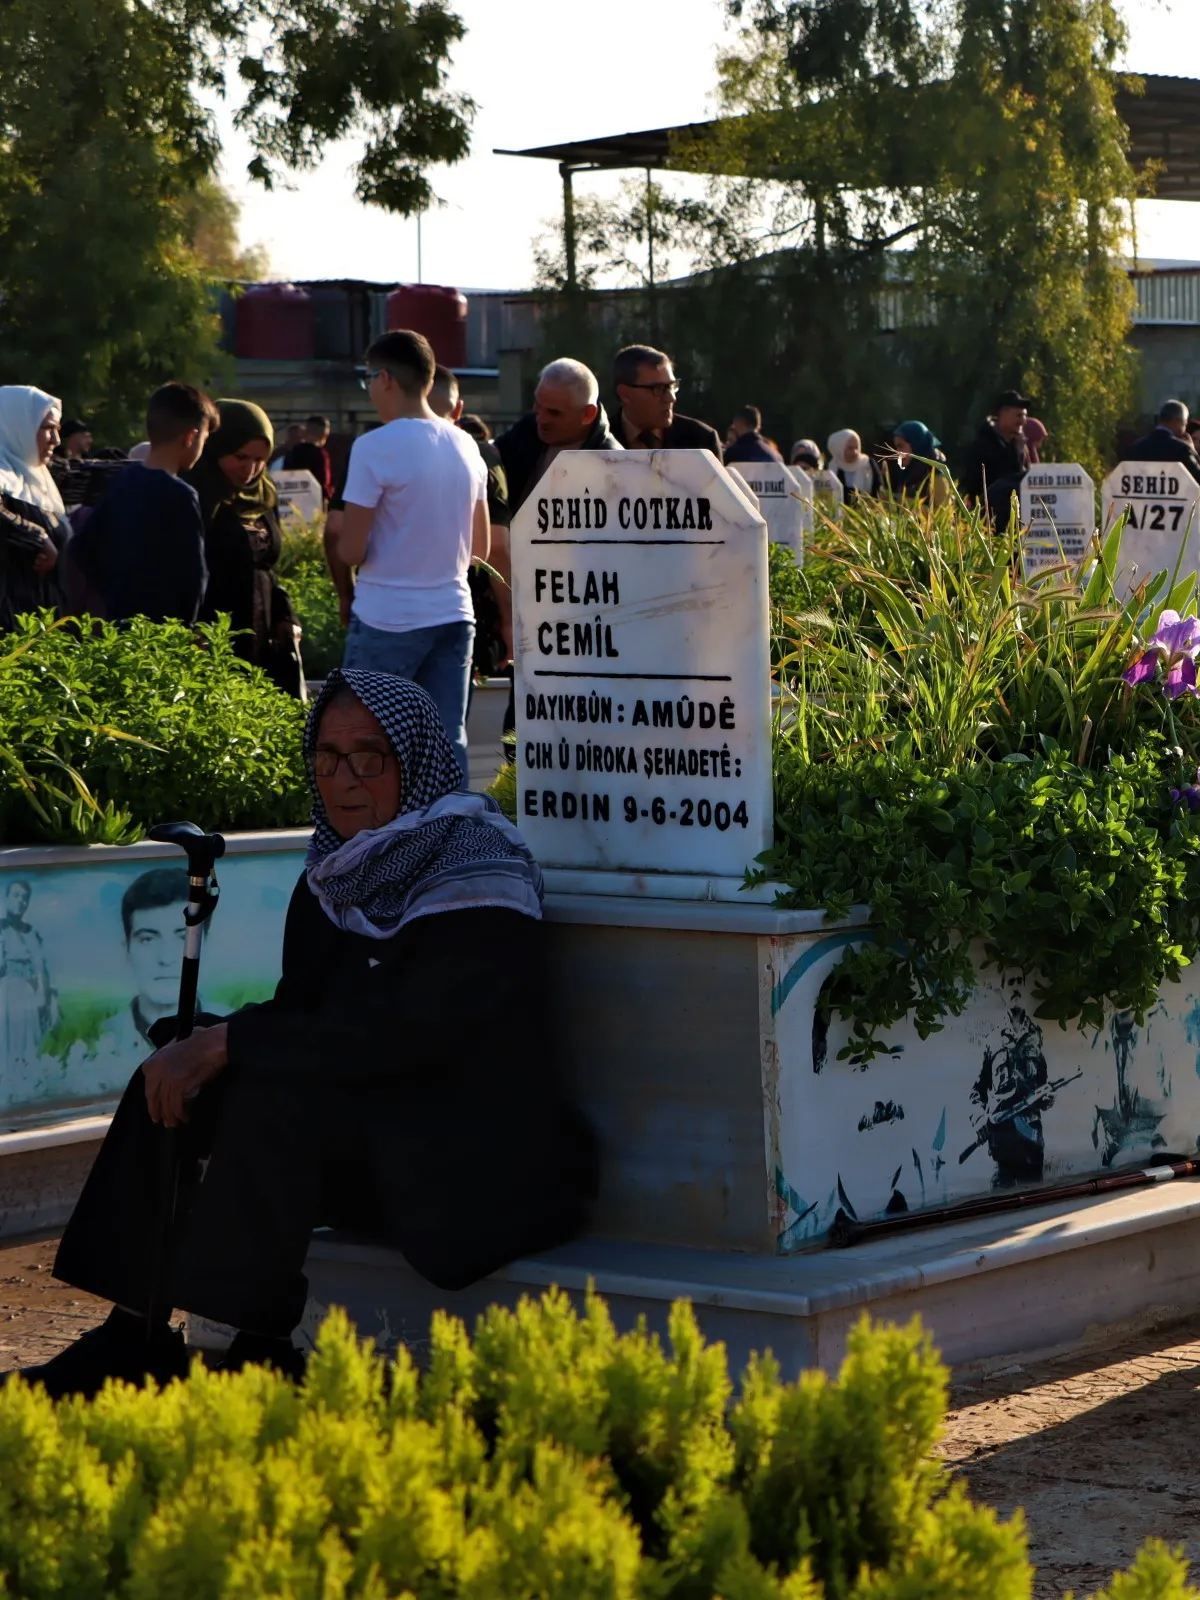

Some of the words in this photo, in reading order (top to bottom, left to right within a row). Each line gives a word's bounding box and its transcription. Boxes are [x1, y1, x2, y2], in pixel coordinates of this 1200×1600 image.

[1121, 470, 1180, 496] ŞEHÎD
[537, 487, 608, 534] ŞEHÎD
[618, 497, 713, 531] COTKAR
[1125, 504, 1185, 531] A/27
[535, 569, 620, 605] FELAH
[537, 615, 619, 658] CEMÎL
[632, 695, 736, 729] AMÛDÊ
[525, 742, 553, 769] CIH
[559, 737, 570, 770] Û
[524, 790, 610, 822] ERDIN
[623, 795, 749, 832] 9-6-2004
